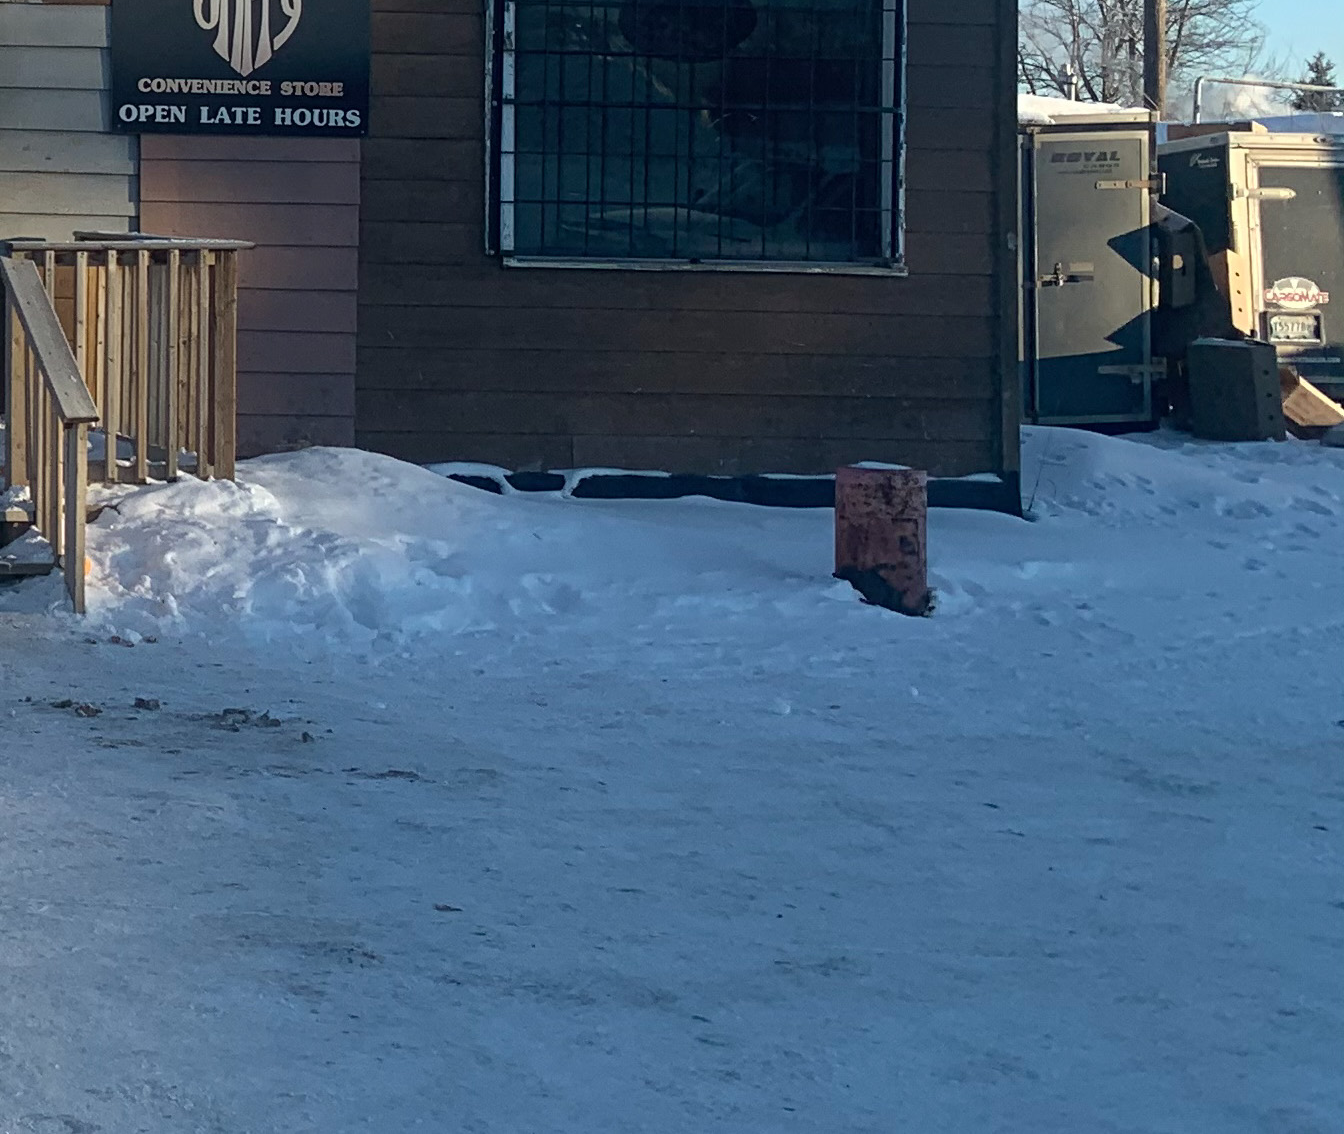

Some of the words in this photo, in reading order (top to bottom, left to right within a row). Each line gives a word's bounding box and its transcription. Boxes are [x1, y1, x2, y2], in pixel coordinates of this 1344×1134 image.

[138, 77, 272, 95] CONVENIENCE
[280, 80, 344, 96] STORE
[118, 104, 186, 123] OPEN
[199, 106, 261, 125] LATE
[274, 108, 361, 128] HOURS
[1050, 151, 1121, 163] ROYAL
